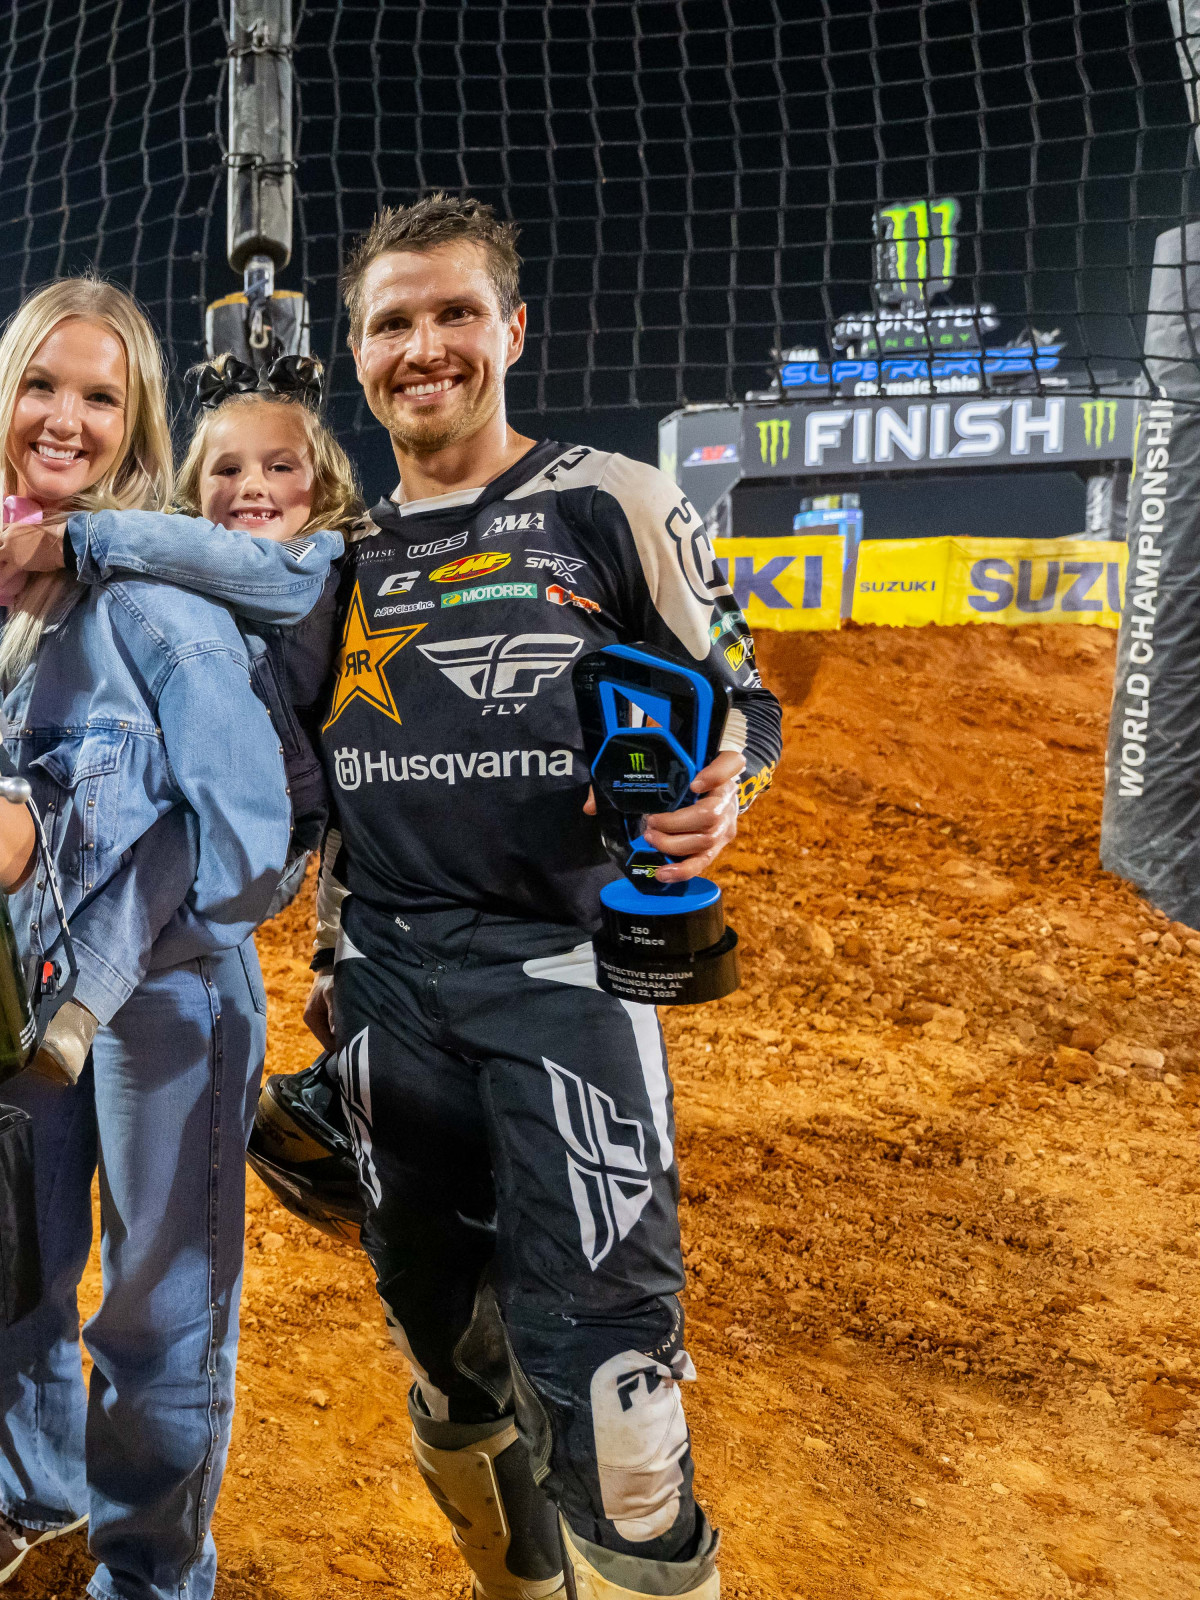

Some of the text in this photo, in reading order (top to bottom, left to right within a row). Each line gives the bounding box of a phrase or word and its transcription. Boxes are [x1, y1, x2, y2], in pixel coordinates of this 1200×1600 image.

[803, 398, 1066, 467] FINISH
[481, 512, 545, 538] AMA
[428, 552, 511, 582] FMF
[462, 584, 534, 602] MOTOREX
[860, 580, 936, 594] SUZUKI
[1118, 386, 1174, 798] WORLD CHAMPIONSHIP
[481, 703, 528, 716] FLY
[364, 749, 575, 785] Husqvarna
[619, 933, 665, 946] 2nd Place
[630, 926, 649, 935] 250
[600, 960, 694, 980] PROTECTIVE STADIUM
[607, 972, 683, 989] BIRMINGHAM, AL
[612, 983, 677, 998] March 22, 2025
